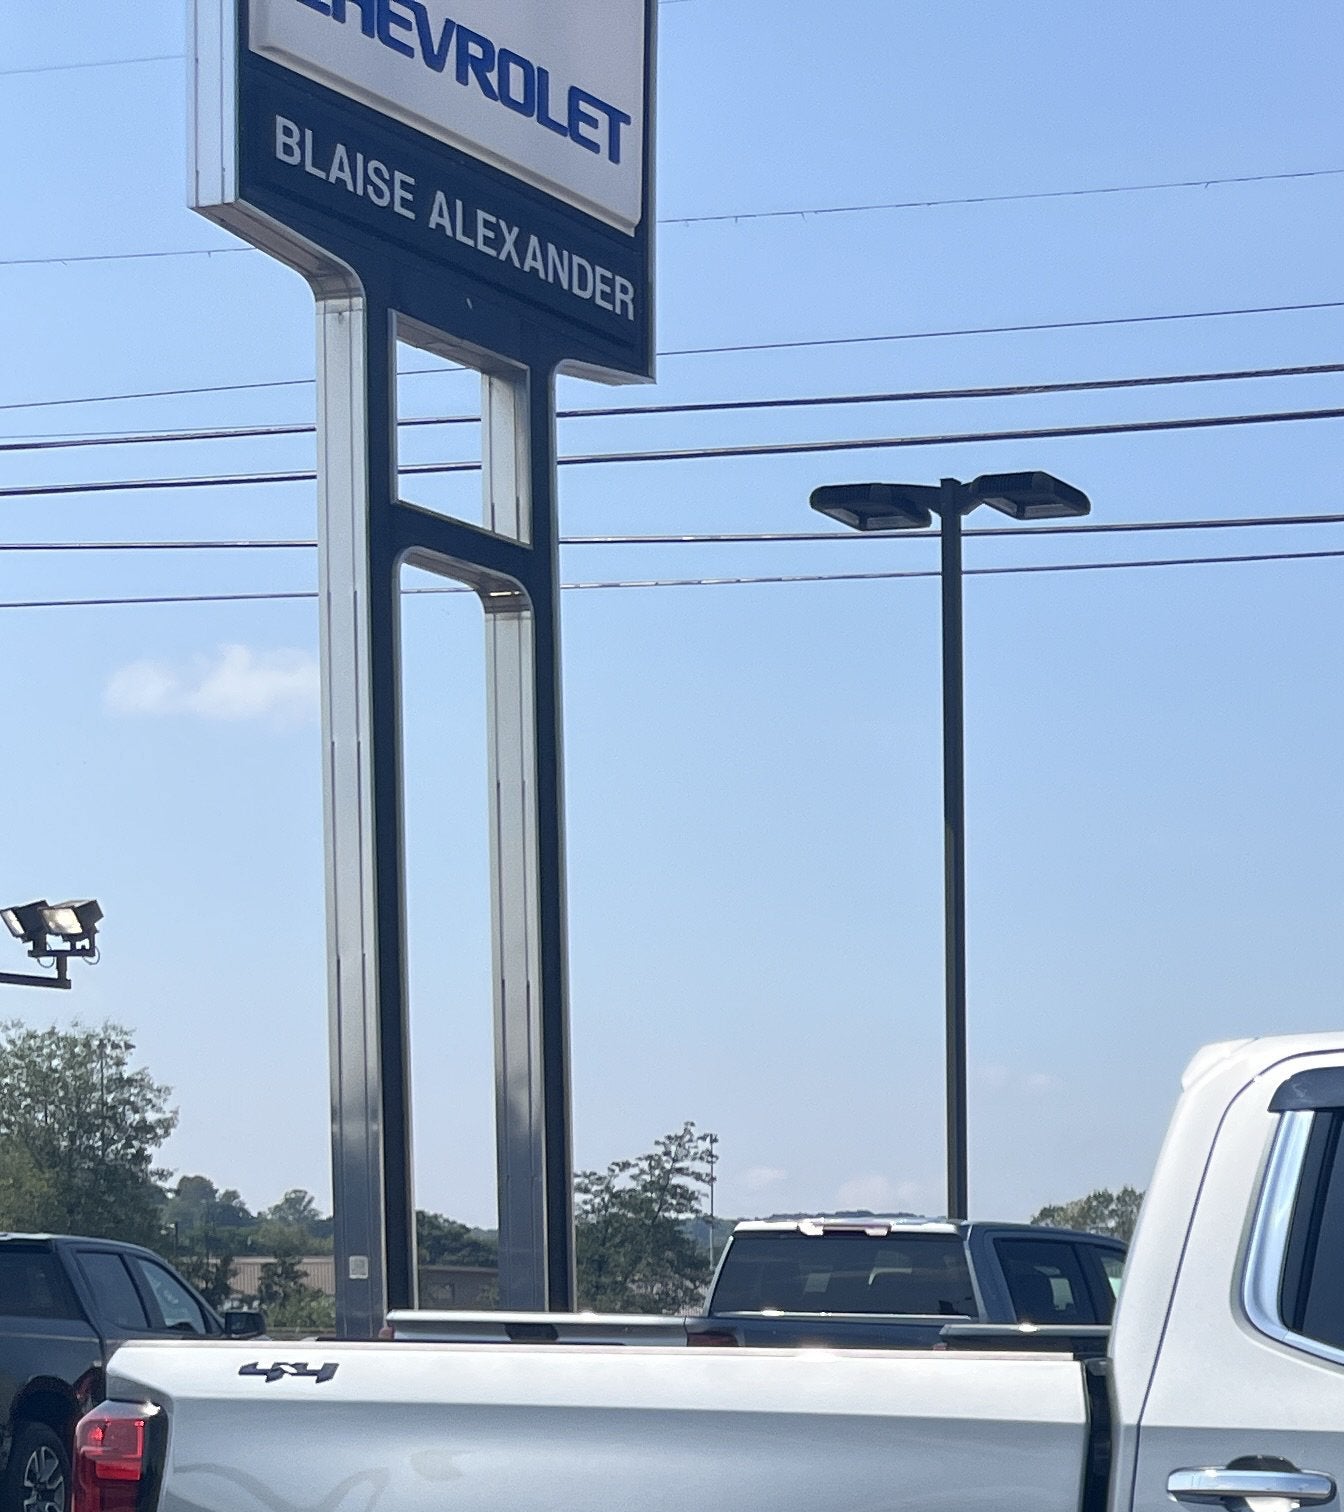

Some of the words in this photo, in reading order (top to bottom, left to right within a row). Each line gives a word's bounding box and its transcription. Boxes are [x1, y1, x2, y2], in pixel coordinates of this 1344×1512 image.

[296, 0, 632, 165] HEVROLET
[274, 114, 417, 221] BLAISE
[428, 190, 636, 322] ALEXANDER
